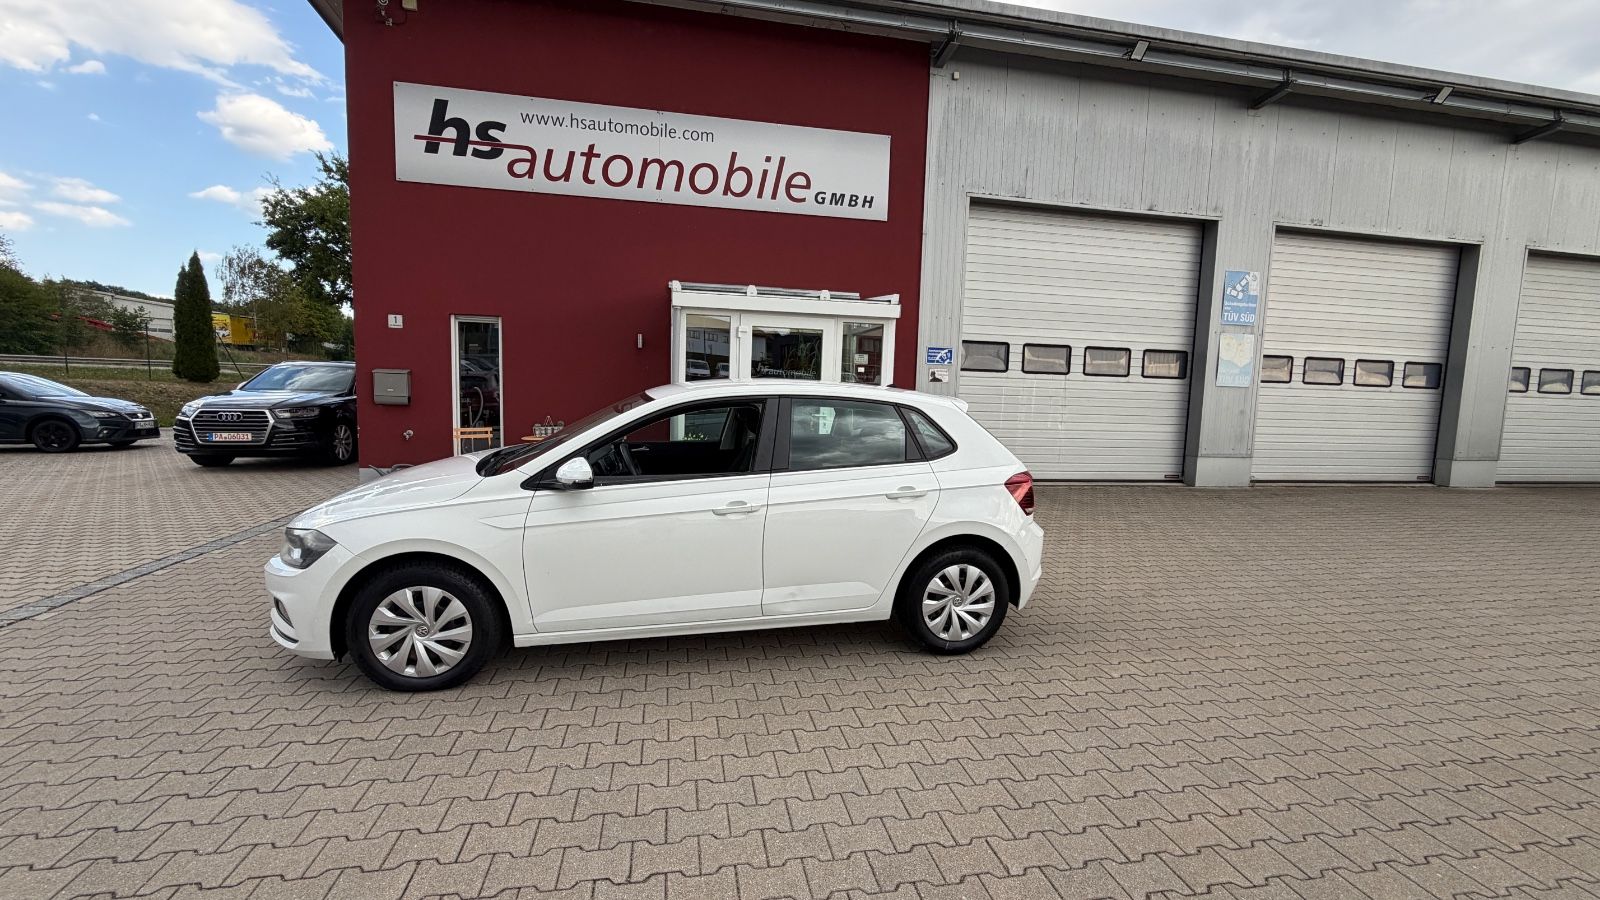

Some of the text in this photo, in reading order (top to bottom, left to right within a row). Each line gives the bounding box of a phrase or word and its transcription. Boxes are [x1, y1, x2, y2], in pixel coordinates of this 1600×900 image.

[423, 98, 507, 160] hs
[520, 112, 714, 143] www.hsautomobile.com
[506, 143, 875, 209] automobile GMBH
[1223, 310, 1255, 323] TÜV SÜD
